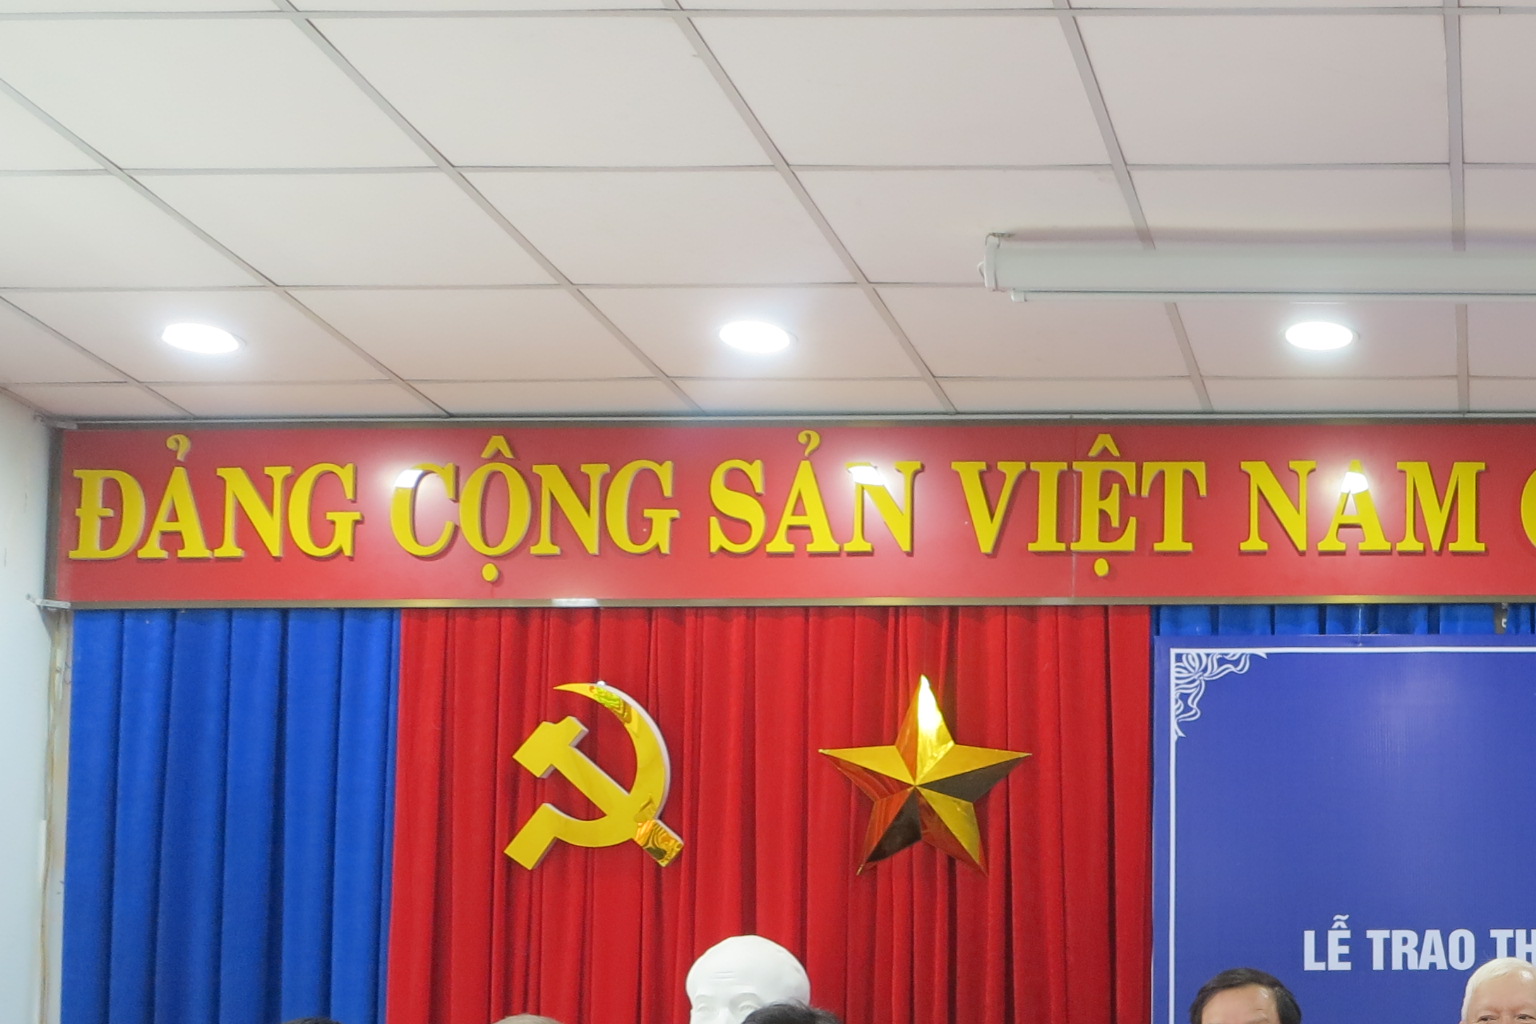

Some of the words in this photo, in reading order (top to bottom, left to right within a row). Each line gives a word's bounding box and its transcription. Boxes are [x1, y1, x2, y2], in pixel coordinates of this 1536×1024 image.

[69, 434, 363, 560] ĐẢNG
[390, 434, 680, 583] CỘNG
[708, 430, 923, 556] SẢN
[951, 433, 1206, 577] VIỆT
[1239, 459, 1486, 555] NAM
[1303, 914, 1352, 971] LỄ
[1366, 928, 1476, 971] TRAO
